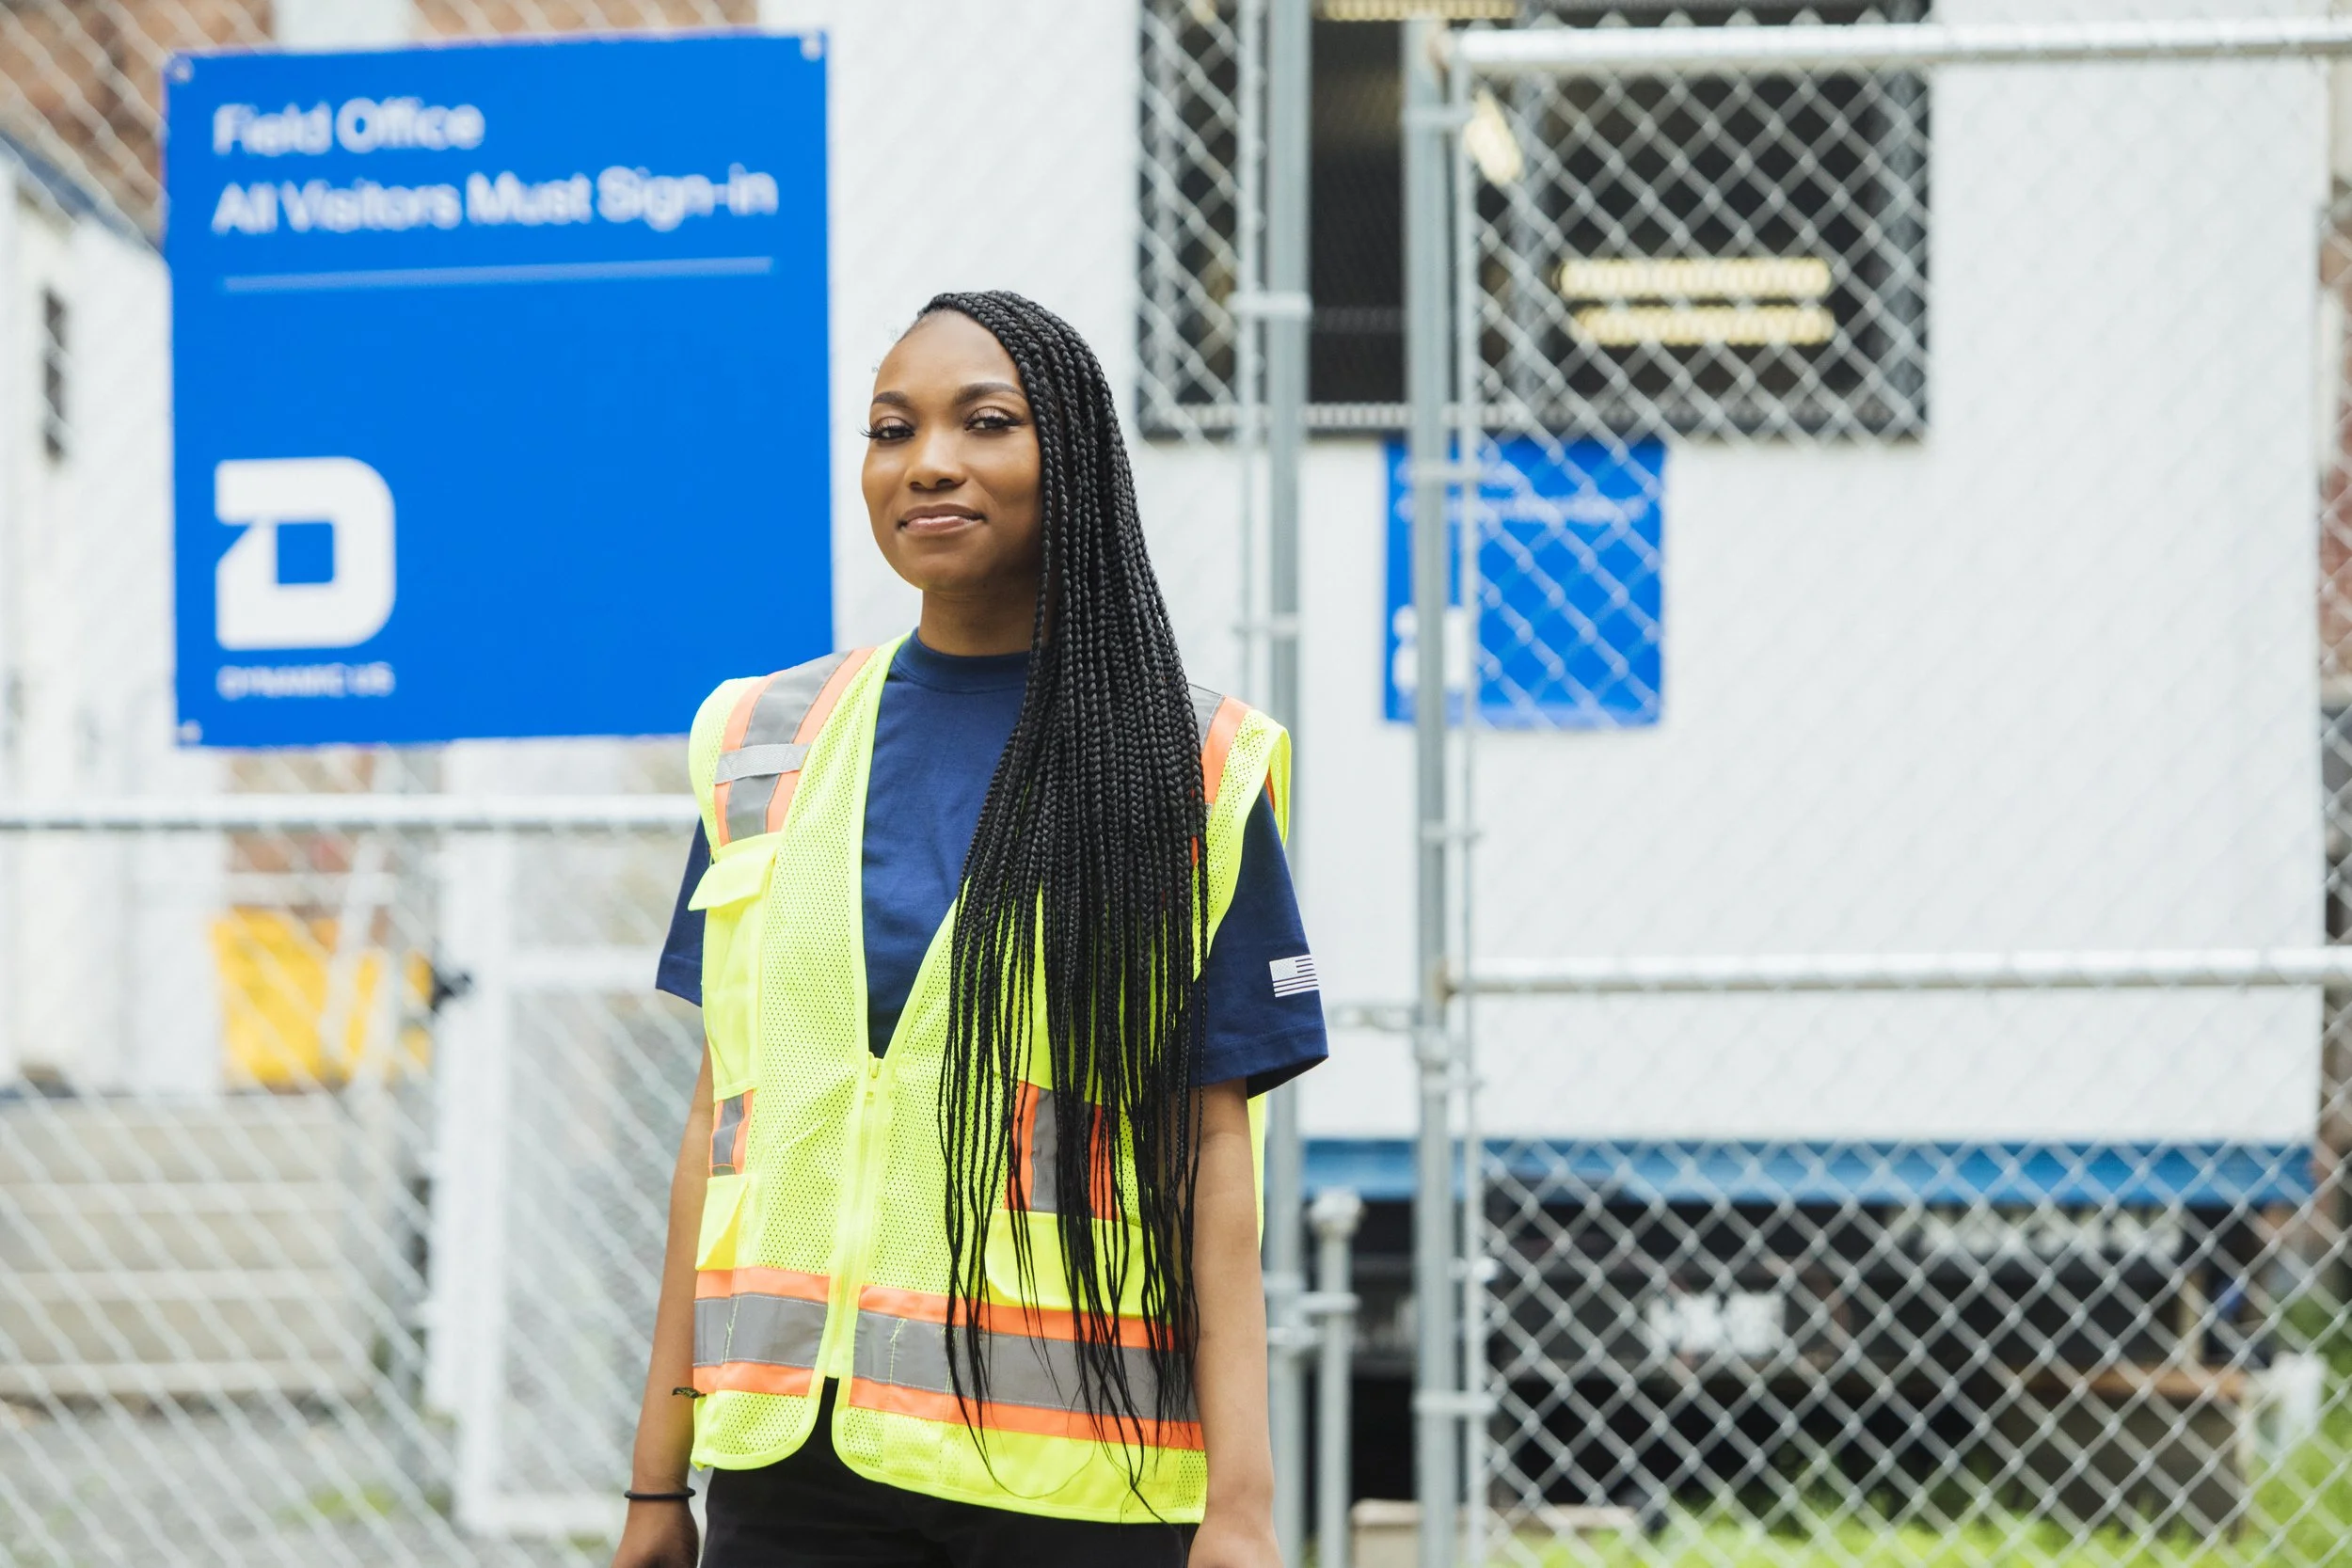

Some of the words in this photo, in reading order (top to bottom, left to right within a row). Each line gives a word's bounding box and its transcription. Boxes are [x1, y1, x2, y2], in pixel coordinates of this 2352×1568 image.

[215, 103, 332, 155] Field
[336, 98, 484, 152] Office
[213, 182, 278, 232] All
[280, 177, 461, 231] Visitors
[467, 170, 592, 224] Must
[597, 163, 778, 230] Sign-in
